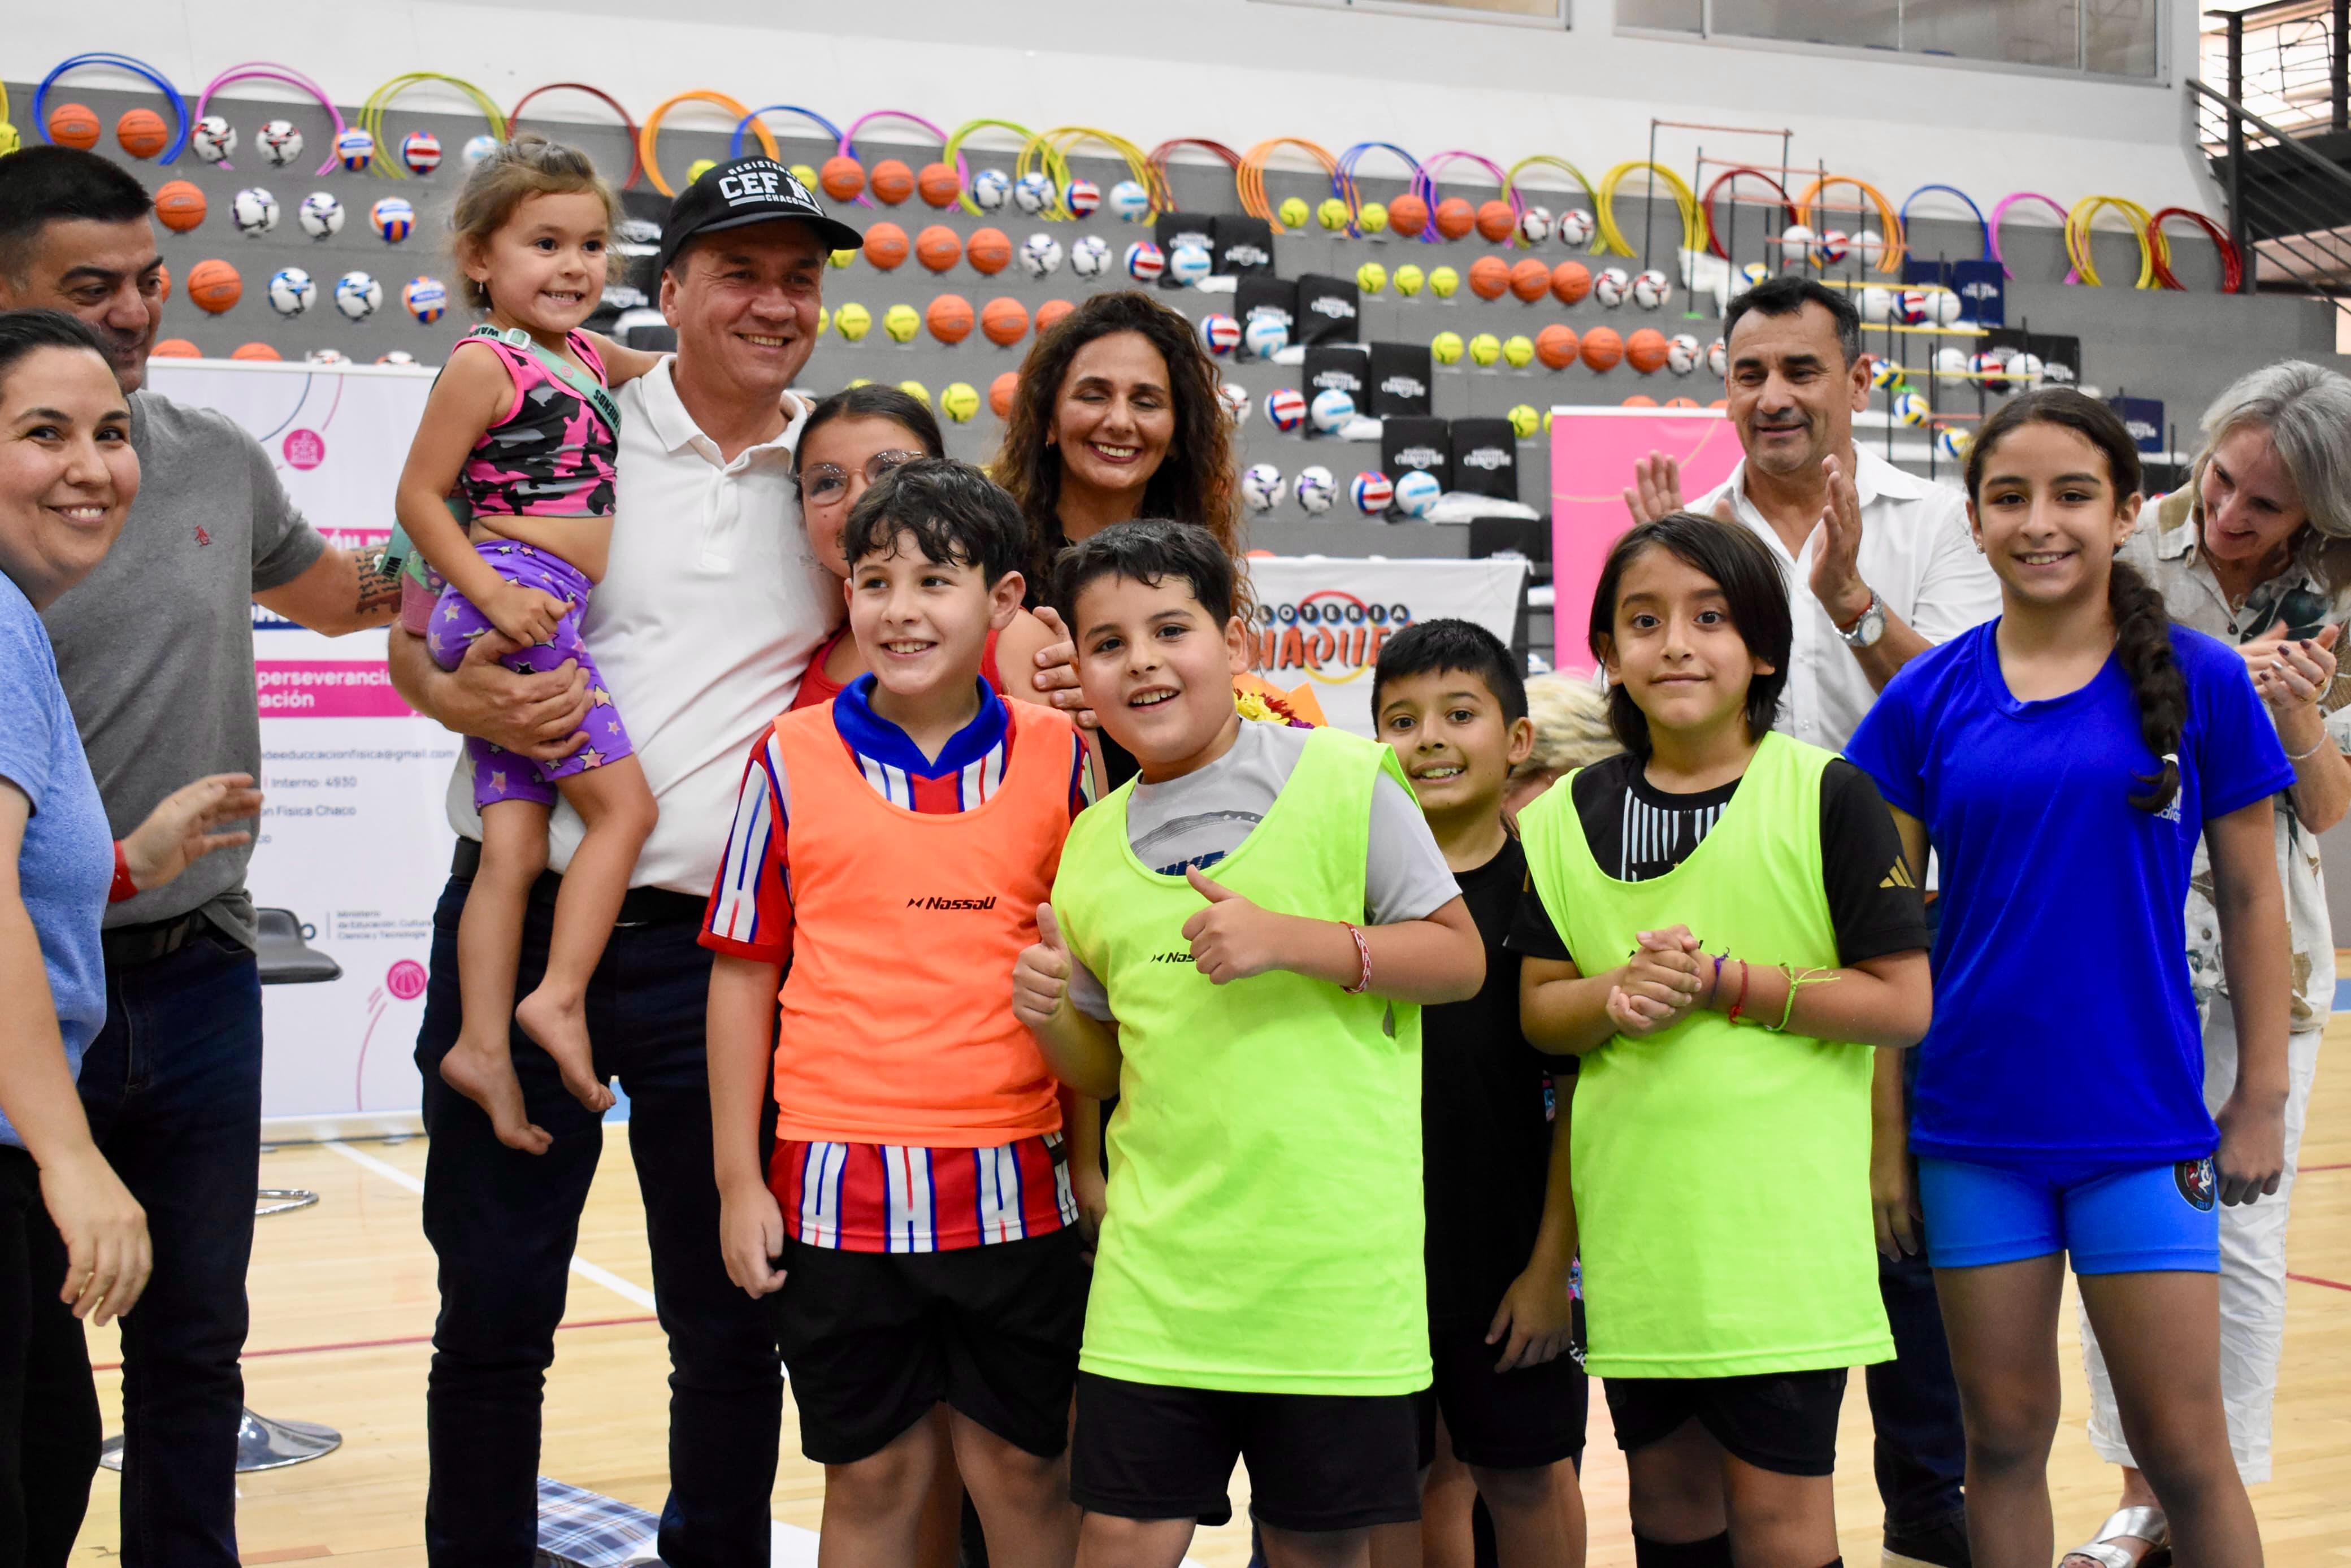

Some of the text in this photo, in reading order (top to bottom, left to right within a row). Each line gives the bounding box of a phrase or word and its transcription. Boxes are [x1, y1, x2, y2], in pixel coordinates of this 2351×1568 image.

[718, 172, 778, 199] CEF
[765, 194, 799, 205] CHACO
[315, 805, 357, 816] Chaco
[1165, 952, 1198, 963] Nas
